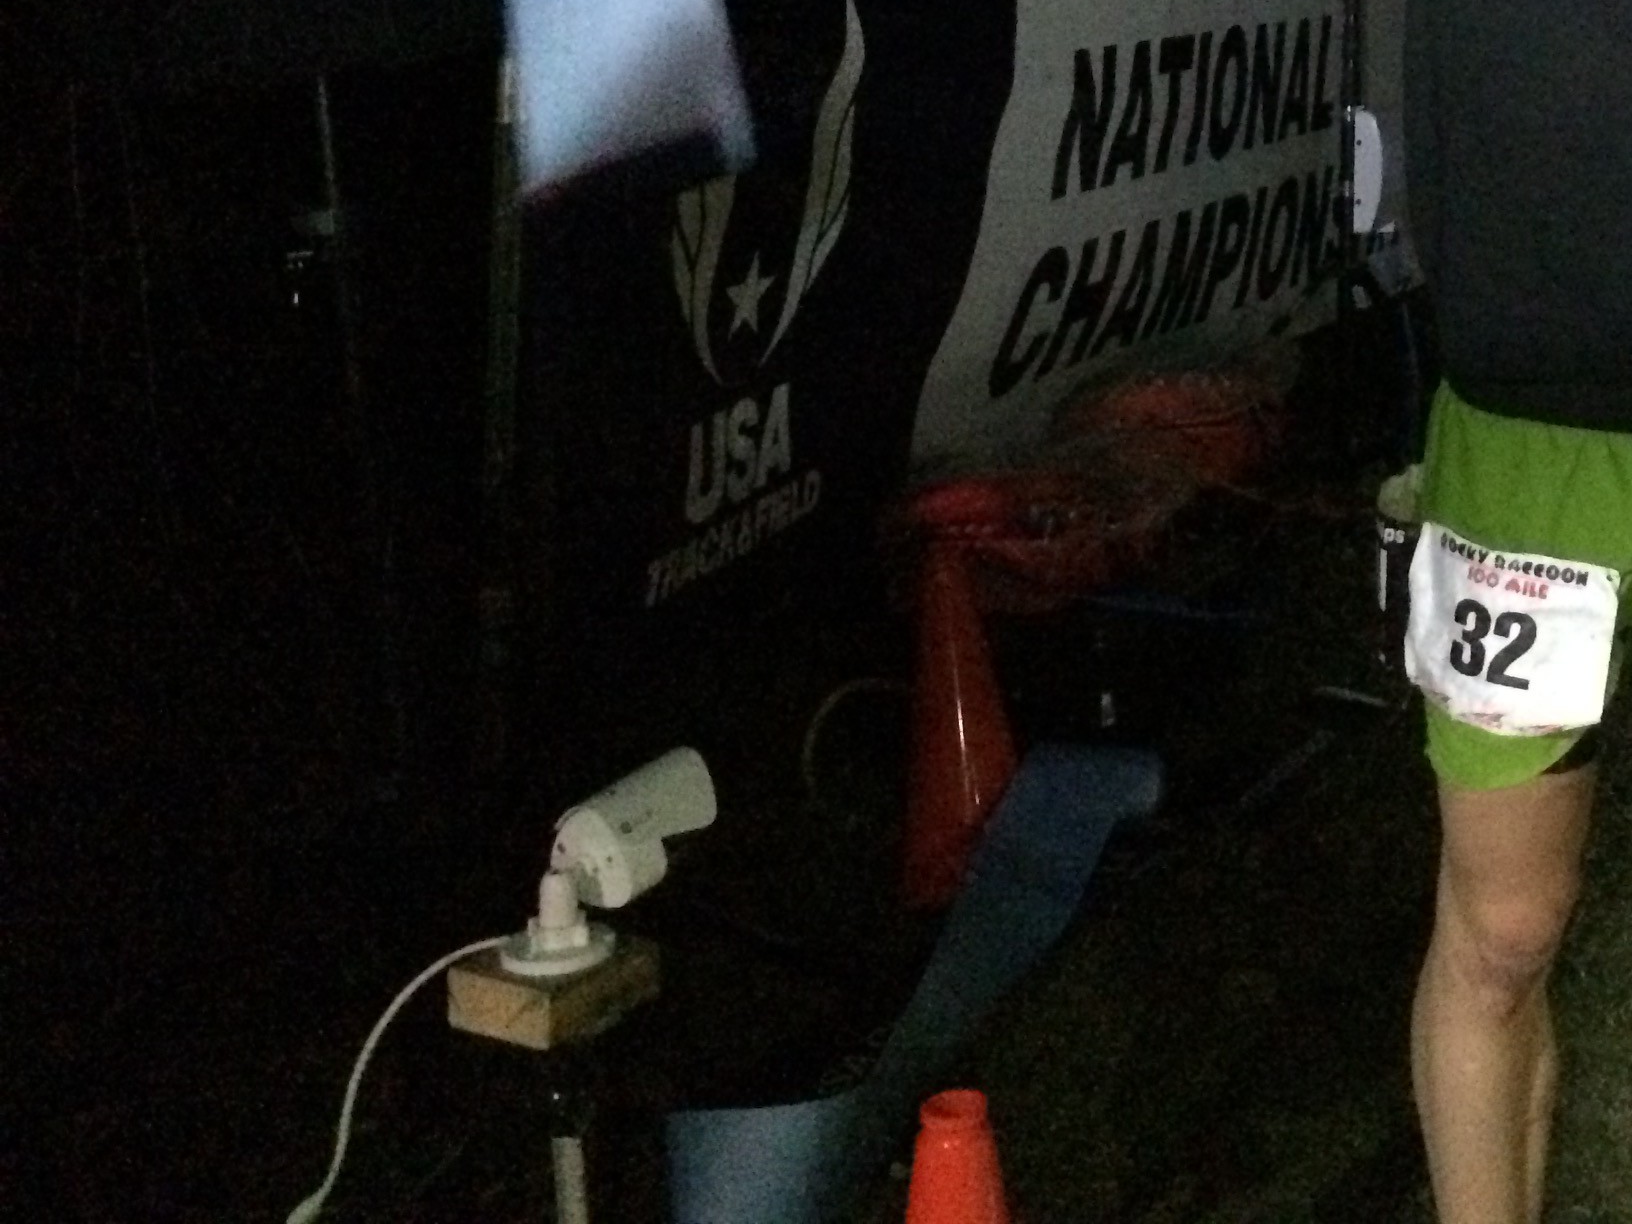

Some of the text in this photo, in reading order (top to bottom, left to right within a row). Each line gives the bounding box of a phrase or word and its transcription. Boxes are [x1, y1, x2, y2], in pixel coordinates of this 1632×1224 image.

[1051, 15, 1332, 201] NATIONAL
[685, 380, 793, 525] USA
[1440, 531, 1589, 587] ROCKY RACCOON
[1467, 564, 1550, 600] 100 MILE
[1450, 598, 1538, 691] 32
